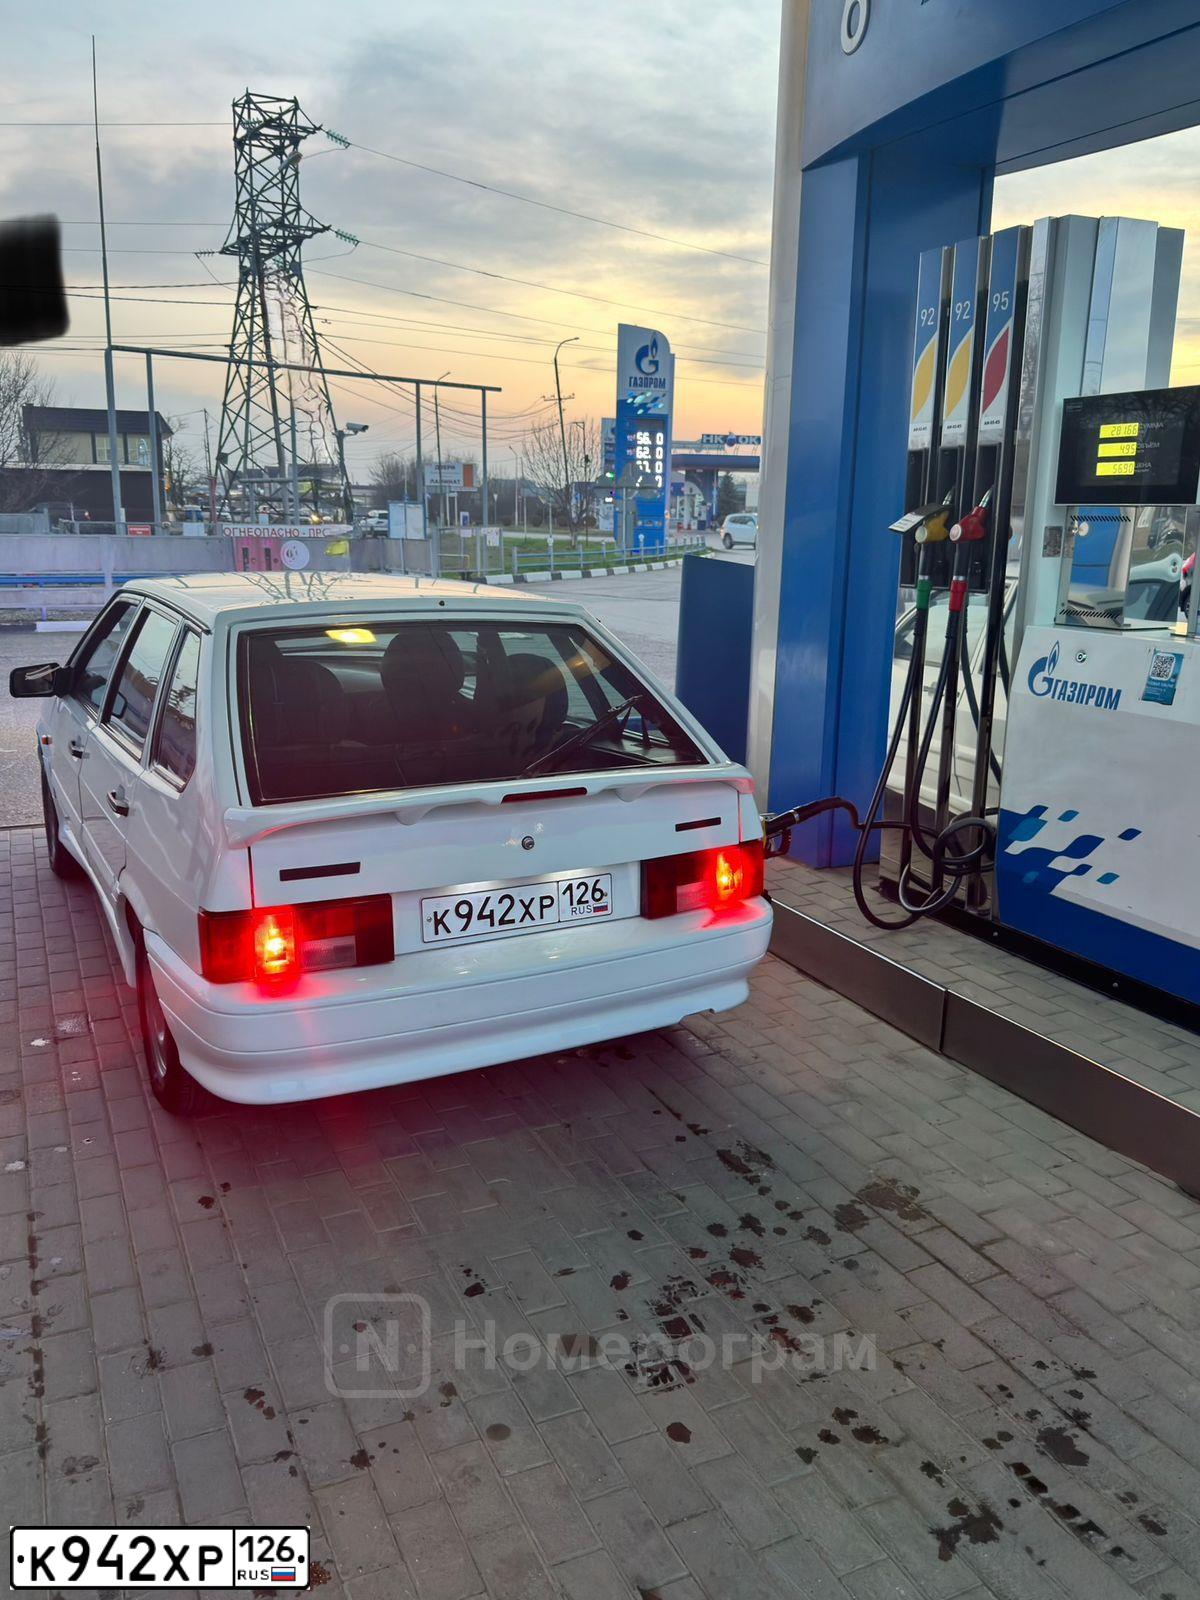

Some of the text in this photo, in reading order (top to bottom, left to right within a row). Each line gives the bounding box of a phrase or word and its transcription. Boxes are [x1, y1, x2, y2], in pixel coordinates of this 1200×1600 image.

[955, 301, 971, 320] 92
[992, 291, 1010, 312] 95
[920, 307, 935, 327] 92
[628, 376, 666, 389] ГАЗПРОМ
[223, 527, 299, 537] ОГНЕОПАСНО
[1051, 679, 1122, 710] ГАЗПРОМ
[433, 879, 605, 936] К942ХР 126
[571, 904, 593, 916] RUS
